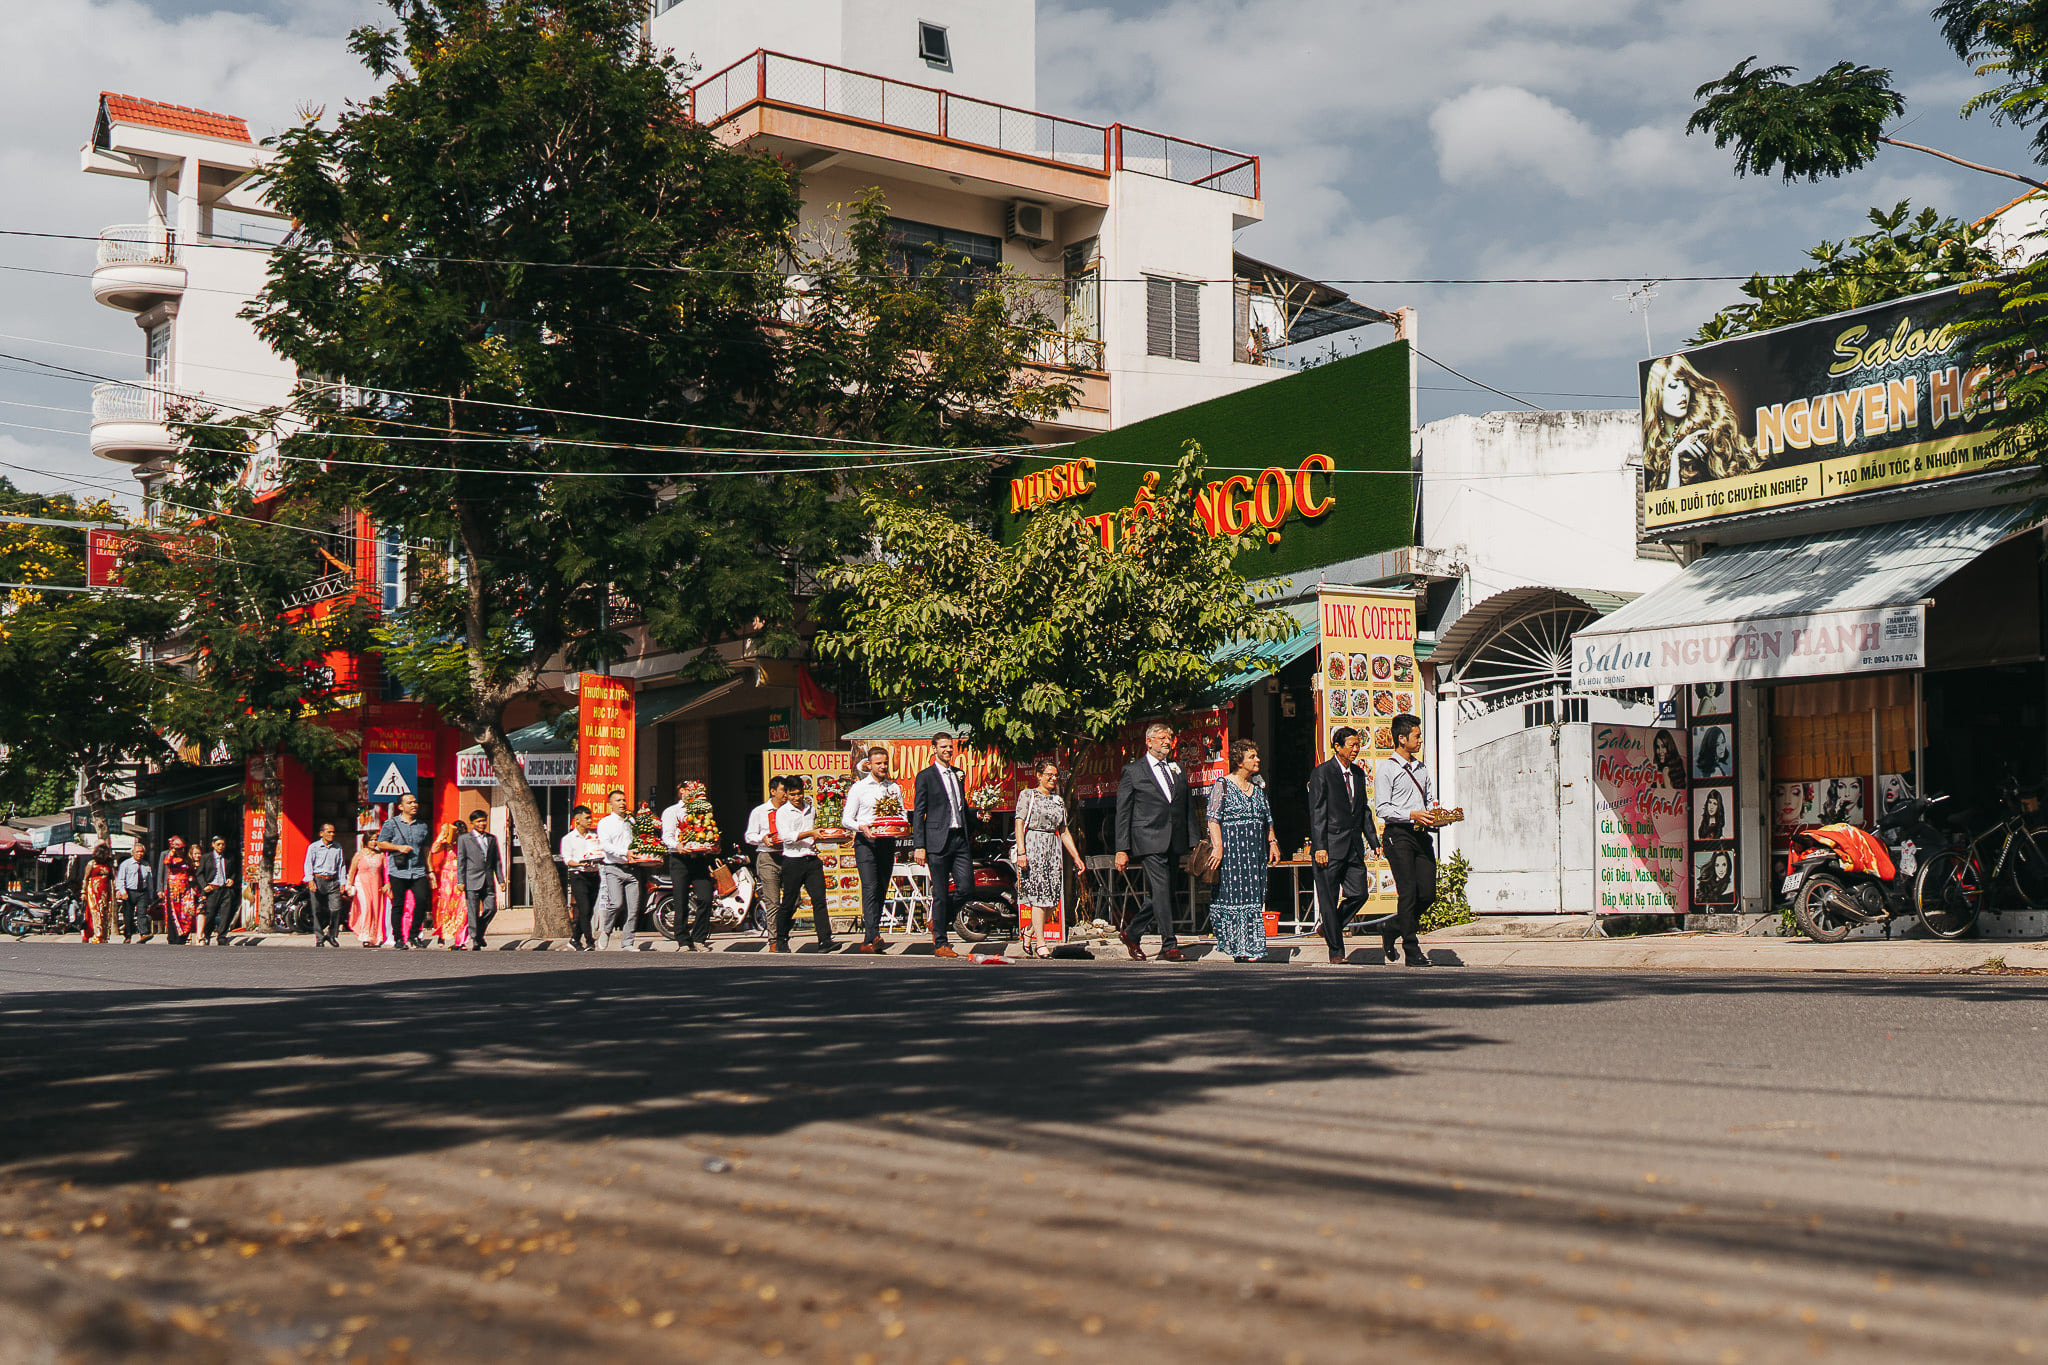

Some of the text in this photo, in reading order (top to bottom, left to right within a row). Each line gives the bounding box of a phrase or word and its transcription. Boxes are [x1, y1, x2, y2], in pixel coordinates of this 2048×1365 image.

[1827, 316, 1957, 378] Salon
[1010, 457, 1097, 514] MUSIC
[1837, 470, 1857, 487] TẠO
[1889, 458, 1910, 475] TÓC
[1914, 457, 1922, 471] &
[1189, 453, 1335, 545] NGỌC
[1707, 489, 1724, 507] TÓC
[1728, 483, 1767, 504] CHUYÊN
[1771, 475, 1808, 496] NGHIỆP
[1324, 603, 1413, 641] LINK COFFEE
[1578, 622, 1881, 674] Salon NGUYÊN HẠNH
[610, 727, 626, 739] THEO
[1597, 728, 1641, 750] Salon
[460, 758, 477, 777] GAS
[773, 753, 804, 770] LINK
[1597, 755, 1664, 788] Nguyên
[582, 783, 606, 794] PHONG
[1637, 788, 1683, 819] Hạnh
[1635, 869, 1657, 882] Massa
[1635, 893, 1645, 909] Nạ
